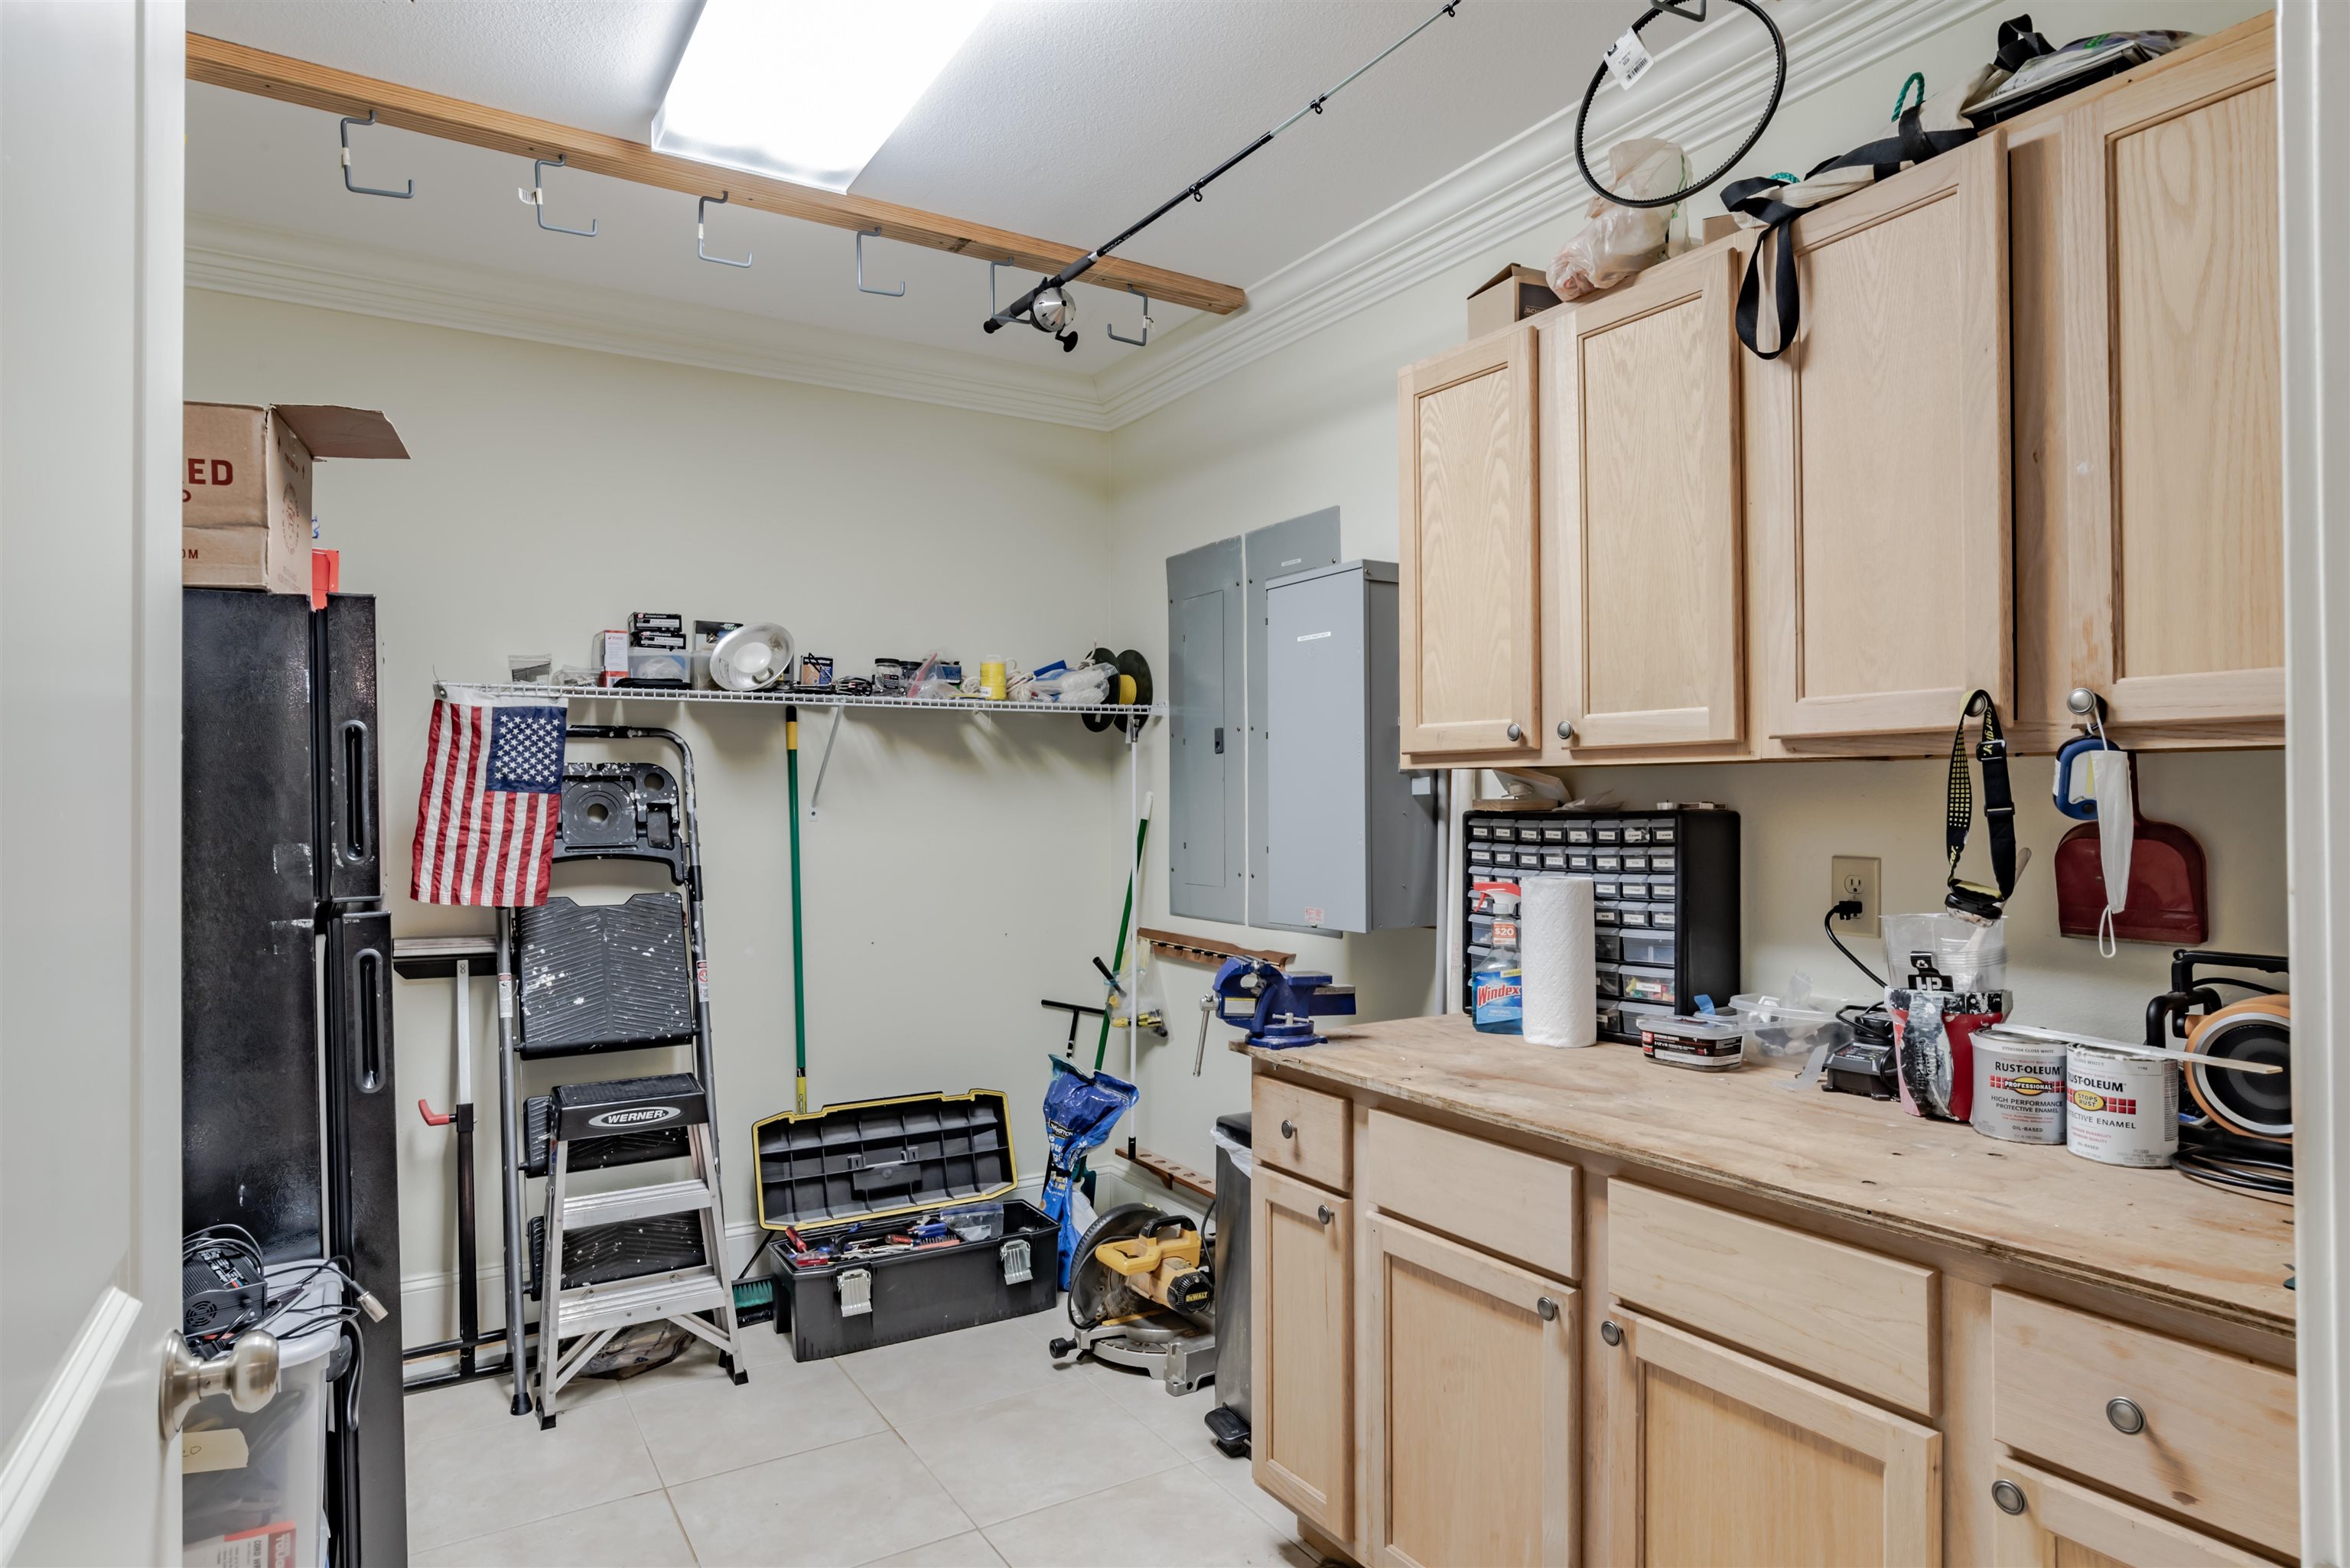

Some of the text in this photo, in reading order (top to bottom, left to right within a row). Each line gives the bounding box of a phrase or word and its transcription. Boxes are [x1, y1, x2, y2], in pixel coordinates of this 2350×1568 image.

[187, 458, 233, 486] ED
[1495, 928, 1515, 936] $20
[1477, 984, 1522, 1007] Windex
[1995, 1062, 2060, 1075] RUST-OLEUM
[2004, 1080, 2052, 1090] PROFESSIONAL
[2068, 1072, 2124, 1092] RUST-OLEUM
[2010, 1098, 2063, 1107] PERFORMANCE
[2078, 1093, 2098, 1102] STOPS
[1996, 1103, 2033, 1113] PROTECTIVE
[607, 1110, 663, 1124] WERNER
[2097, 1117, 2136, 1129] ENAMEL
[253, 1540, 262, 1557] CORD
